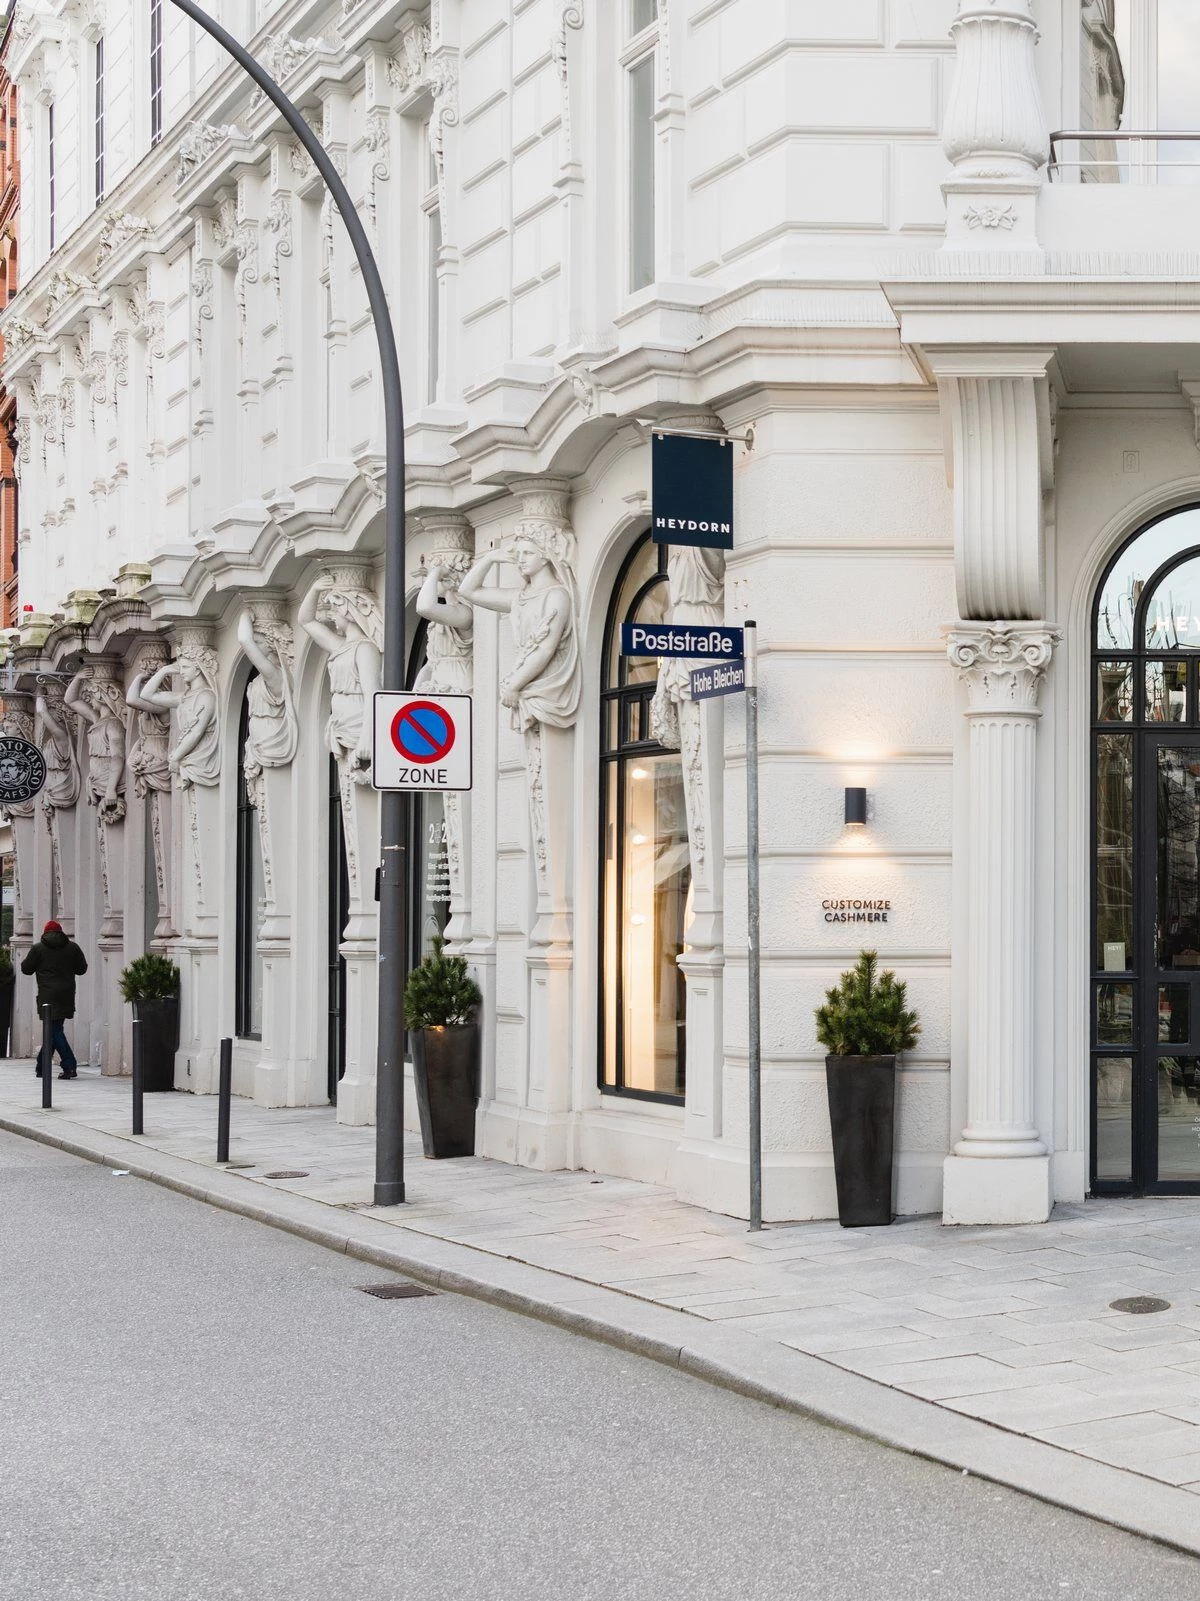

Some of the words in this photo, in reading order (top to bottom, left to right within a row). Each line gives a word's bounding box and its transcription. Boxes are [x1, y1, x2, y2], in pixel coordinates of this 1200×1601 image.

[656, 517, 730, 533] HEYDORN
[632, 628, 733, 653] Poststraße
[693, 673, 712, 693] Hohe
[713, 666, 744, 689] Bleichen
[25, 747, 42, 785] TASSO
[399, 768, 448, 784] ZONE
[821, 899, 891, 910] CUSTOMIZE
[824, 912, 888, 923] CASHMERE
